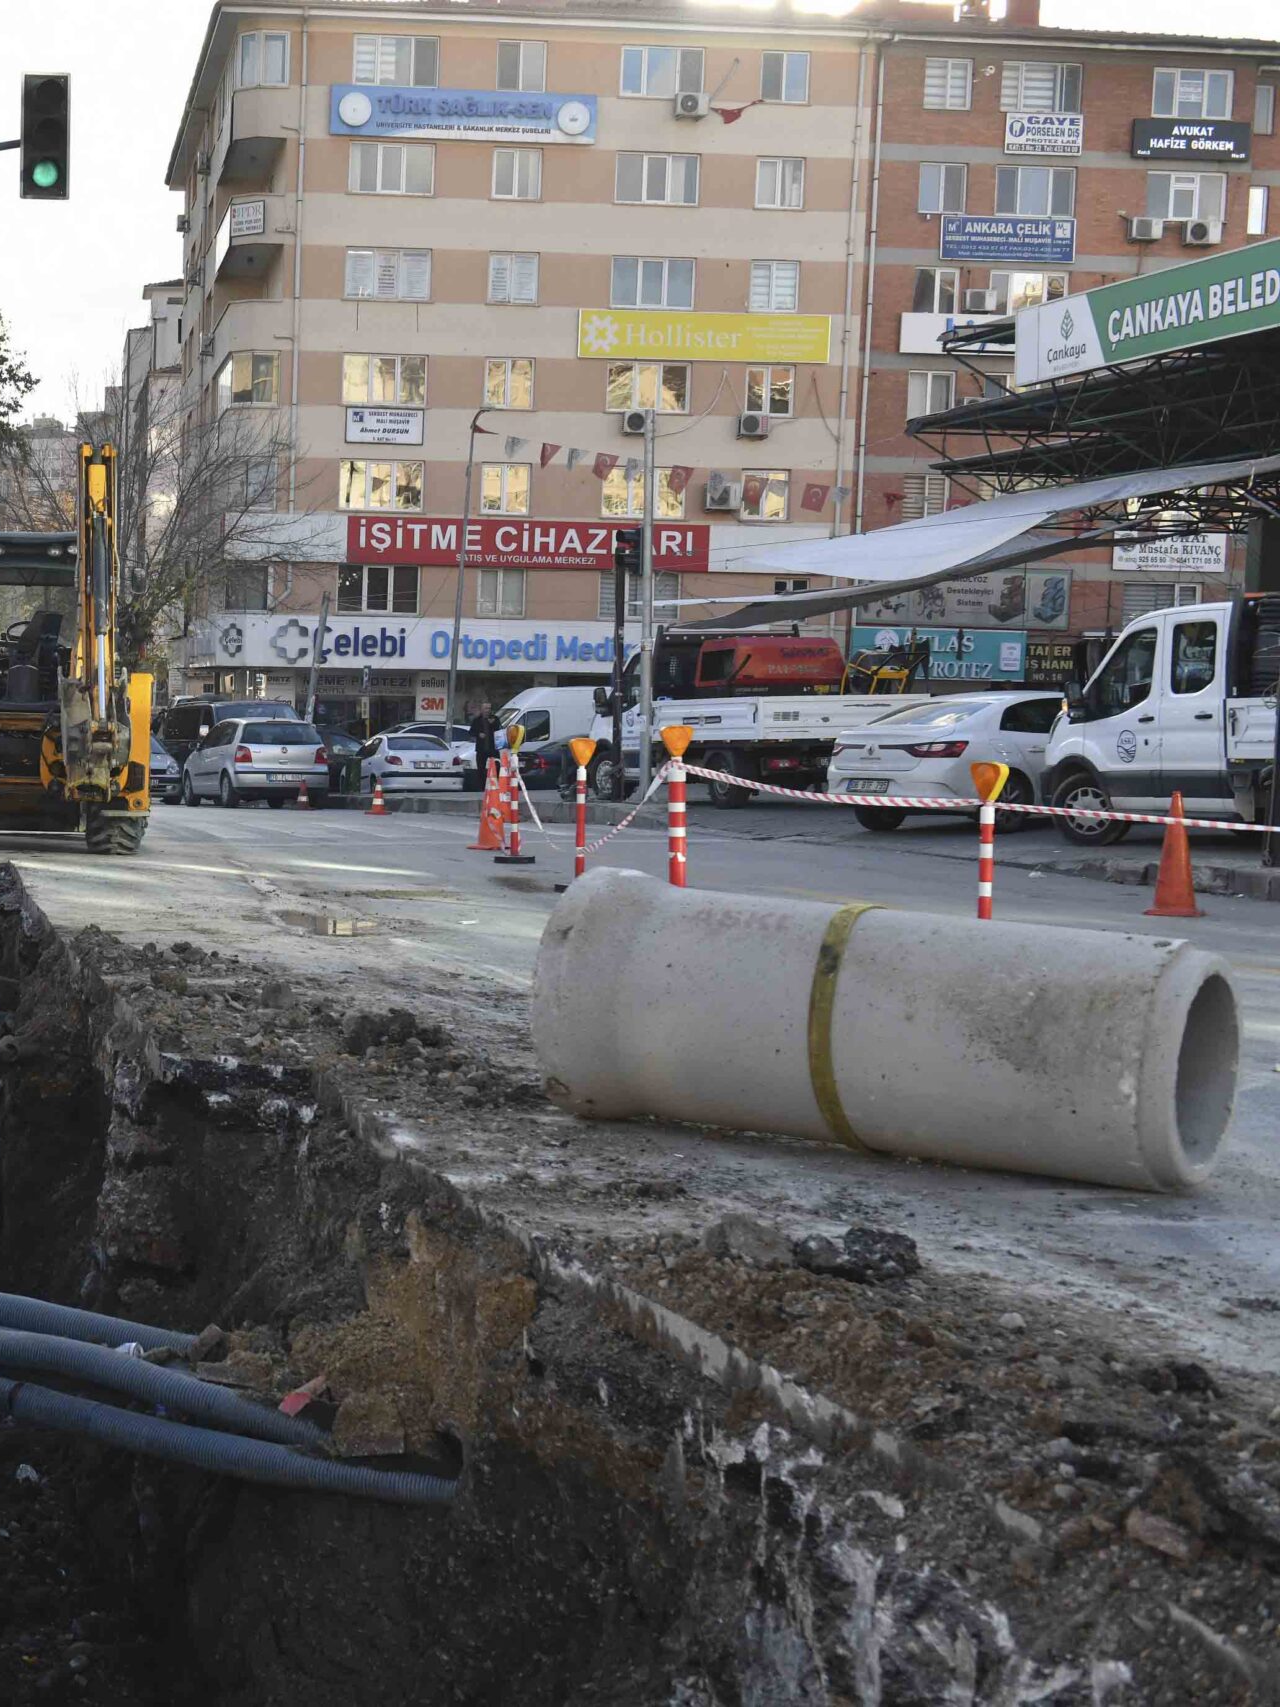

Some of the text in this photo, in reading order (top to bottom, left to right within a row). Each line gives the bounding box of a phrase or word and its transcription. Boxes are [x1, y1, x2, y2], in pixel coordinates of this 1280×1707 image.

[377, 94, 554, 120] TÜRK SAĞLIK-SEN
[1027, 116, 1081, 126] GAYE
[1026, 127, 1065, 138] PORSELEN
[1172, 126, 1215, 136] AVUKAT
[1150, 137, 1234, 151] HAFİZE GÖRKEM
[965, 221, 1051, 237] ANKARA ÇELİK
[1107, 289, 1204, 351] ÇANKAYA
[625, 322, 743, 349] Hollister
[1047, 342, 1086, 364] Çankaya
[359, 518, 483, 553] İŞİTME
[1139, 543, 1222, 557] Mustafa KIVANÇ
[484, 555, 498, 563] VE
[500, 555, 553, 565] UYGULAMA
[947, 587, 994, 596] Destekleyici
[957, 599, 983, 607] Sistem
[314, 625, 406, 665] Çelebi
[1041, 659, 1073, 669] HANI
[421, 678, 445, 689] BRAUN
[421, 698, 445, 711] 3M
